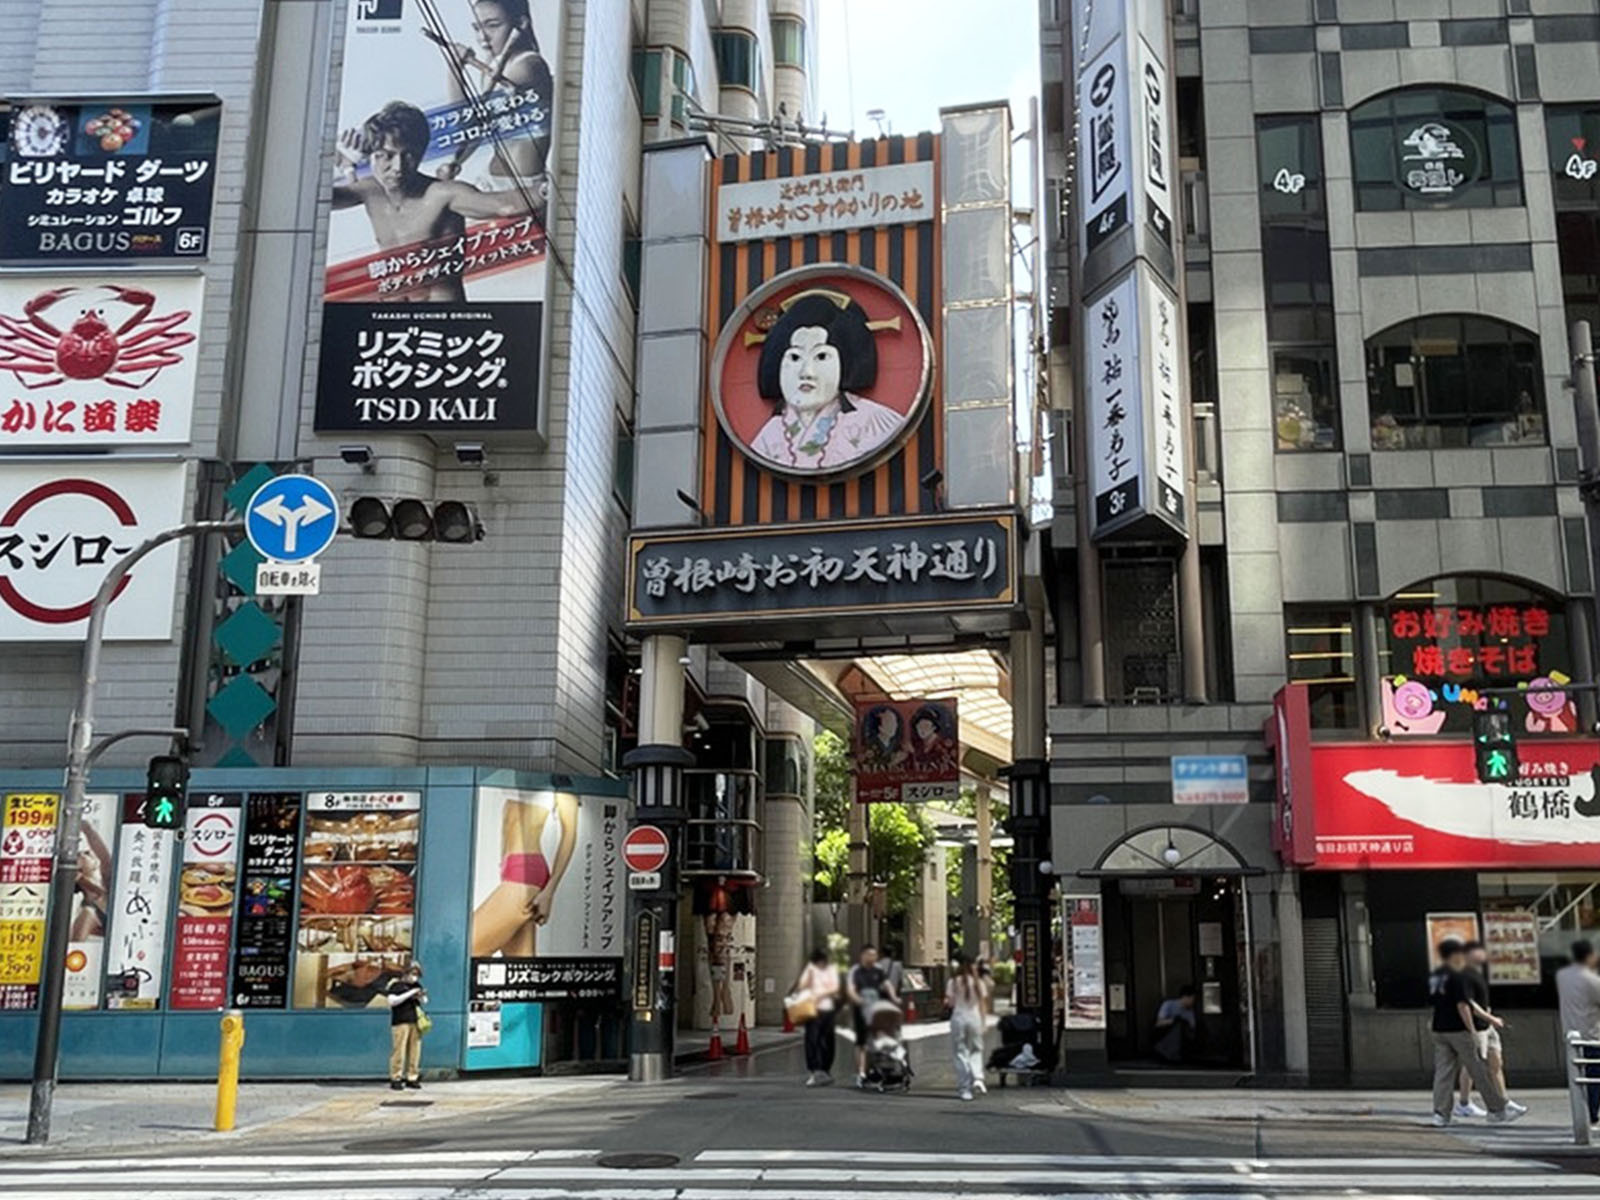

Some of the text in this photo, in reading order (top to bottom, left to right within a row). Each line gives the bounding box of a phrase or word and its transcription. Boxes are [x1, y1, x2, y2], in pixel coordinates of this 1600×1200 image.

[10, 160, 208, 184] ビリヤード ダーツ
[1566, 153, 1598, 178] 4F
[1274, 168, 1306, 193] 4F
[46, 187, 165, 205] カラオケ 卓球
[28, 207, 182, 226] シミュレーション ゴルフ
[39, 232, 130, 251] BAGUS
[178, 232, 201, 248] 6F
[372, 312, 411, 320] TAKASHI
[450, 312, 493, 320] ORIGINAL
[358, 327, 504, 359] リズミック
[355, 398, 497, 421] TSD KALI
[0, 533, 132, 569] スシロー
[643, 537, 997, 597] 曽根崎お初天神通り
[259, 571, 316, 588] 自転車を除く
[1392, 608, 1550, 638] お好み焼き
[1413, 646, 1536, 676] 焼きそば
[908, 785, 954, 798] スシロー
[10, 797, 55, 808] 生ビール
[1508, 790, 1569, 819] 鶴橋
[9, 810, 53, 825] 199円
[192, 830, 235, 841] スシロー
[248, 834, 294, 845] ビリヤード
[264, 846, 294, 857] ダーツ
[239, 965, 286, 977] BAGUS
